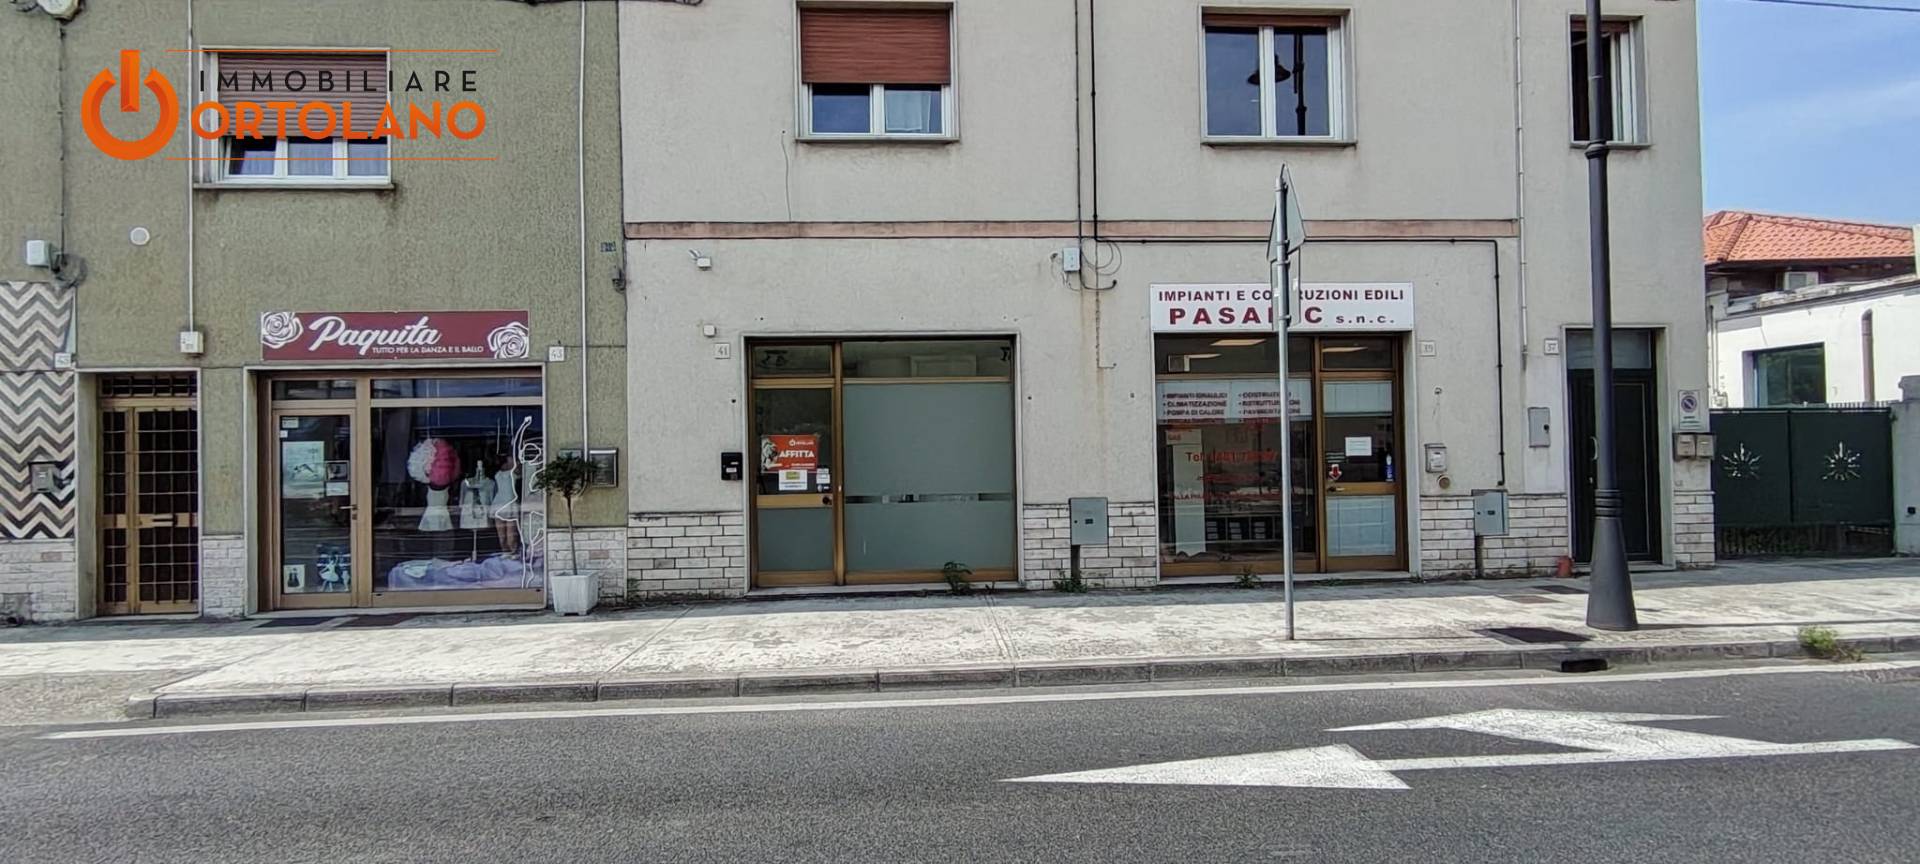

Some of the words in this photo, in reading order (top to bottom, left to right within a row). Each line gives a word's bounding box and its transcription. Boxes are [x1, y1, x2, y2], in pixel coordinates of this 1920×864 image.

[1158, 290, 1231, 301] IMPIANTI
[1237, 290, 1246, 300] E
[1251, 289, 1359, 301] COUZIONI
[1364, 289, 1404, 300] EDILI
[1169, 306, 1323, 325] PASAC
[1335, 314, 1395, 324] s.n.c.
[308, 315, 442, 355] Paquita
[372, 346, 395, 354] TUTTO
[396, 346, 409, 354] PER
[779, 450, 815, 458] AFFITTA
